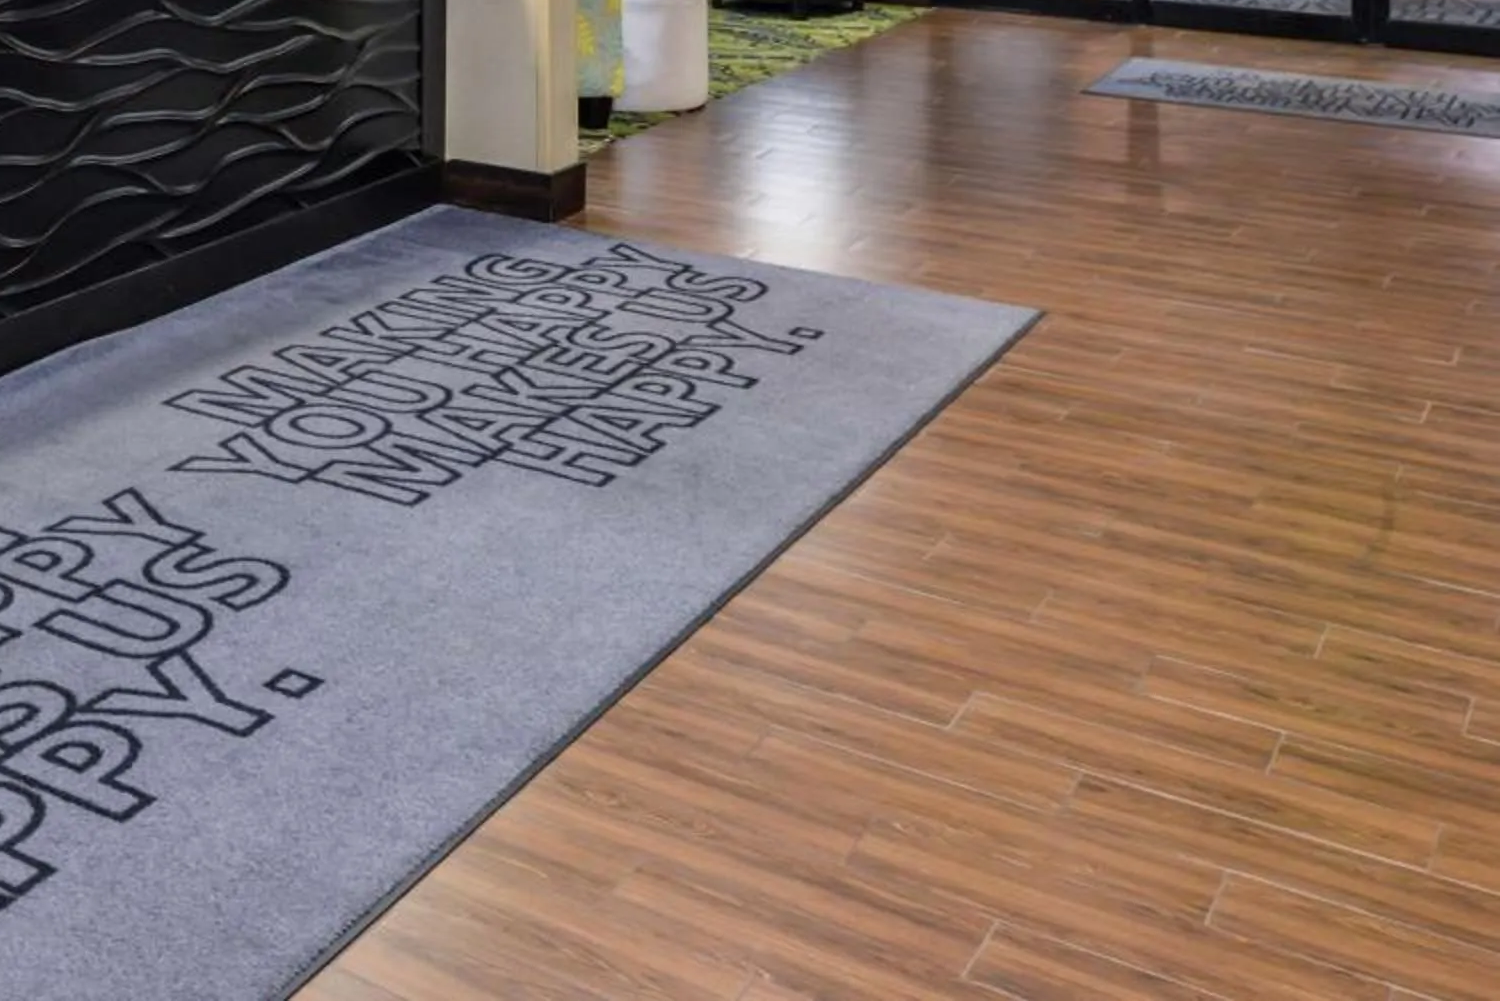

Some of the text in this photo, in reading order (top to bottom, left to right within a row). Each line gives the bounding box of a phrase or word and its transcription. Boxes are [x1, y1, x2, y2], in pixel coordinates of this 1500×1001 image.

[162, 253, 574, 428] MAKING
[165, 242, 694, 484] YOU HAPPY
[309, 266, 769, 507] MAKES US
[493, 317, 824, 487] HAPPY.
[34, 541, 291, 659] US
